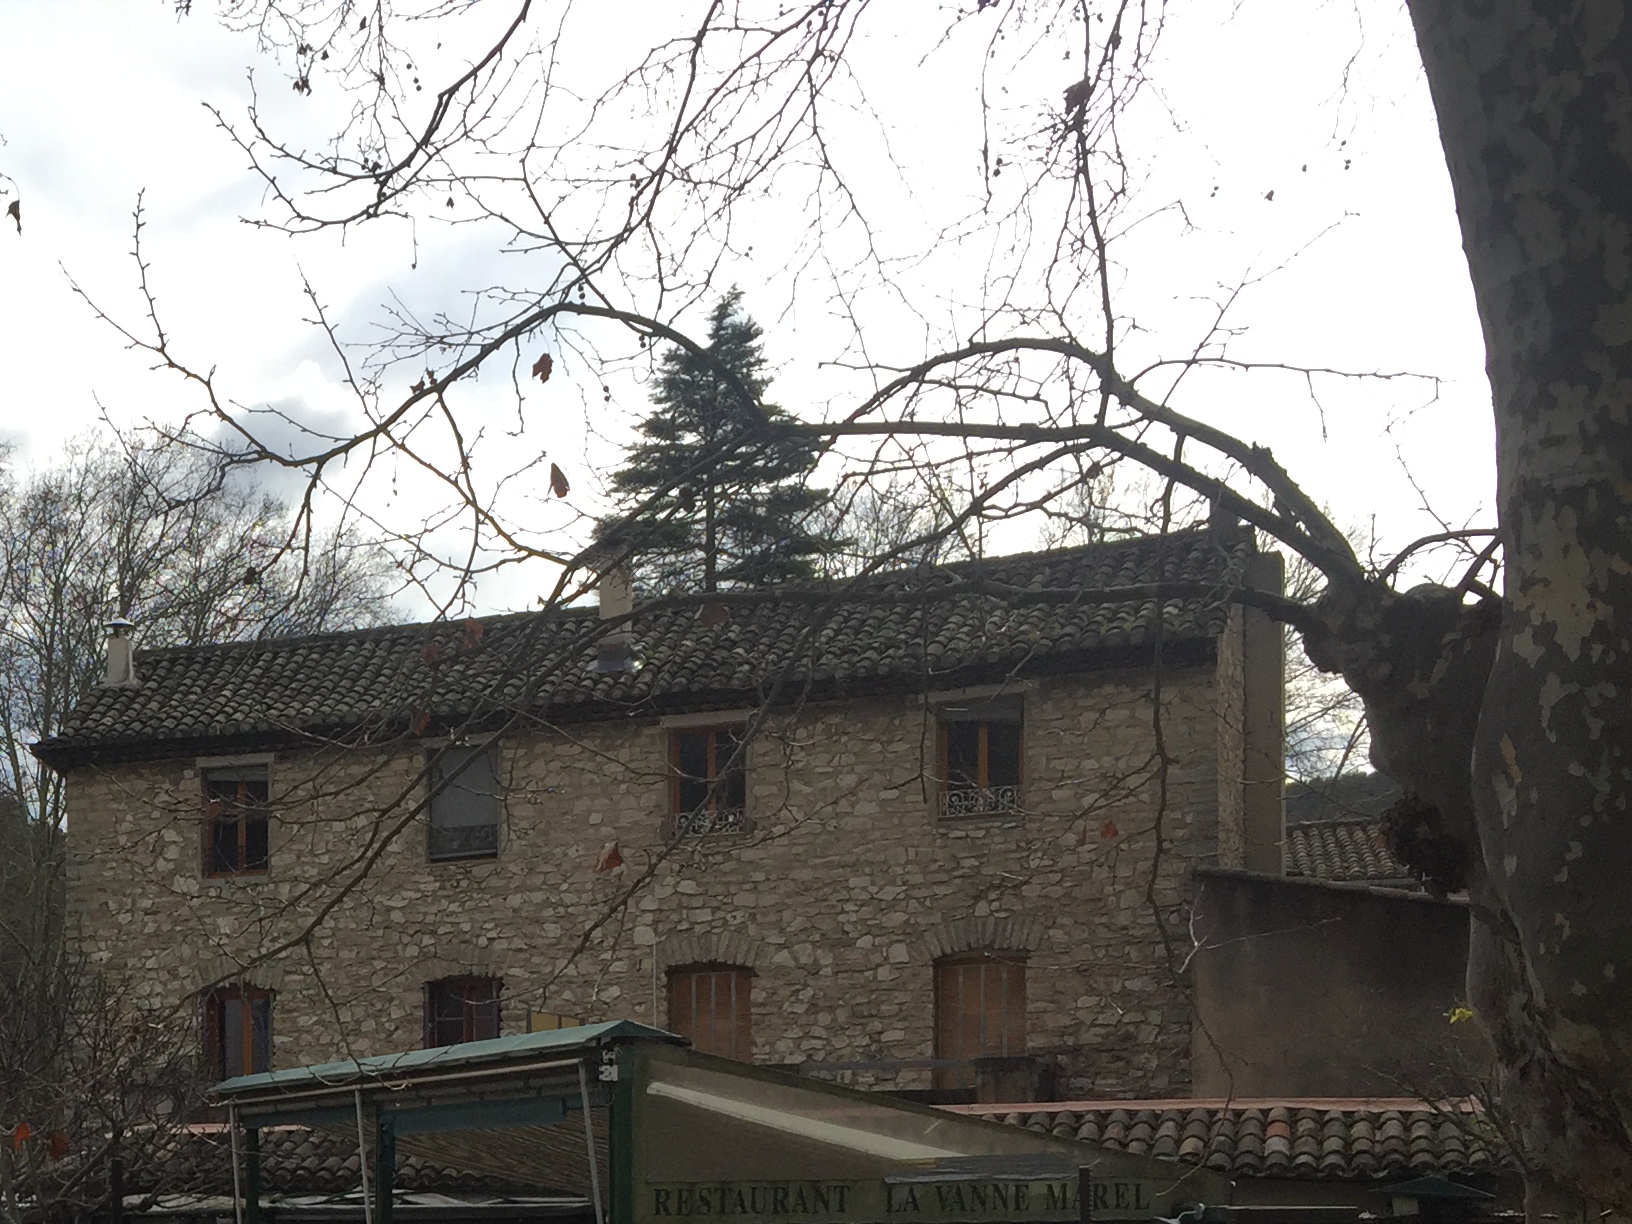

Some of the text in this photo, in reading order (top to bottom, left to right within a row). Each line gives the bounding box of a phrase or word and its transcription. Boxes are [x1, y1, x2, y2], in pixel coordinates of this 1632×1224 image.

[653, 1184, 851, 1217] RESTAURANT
[885, 1184, 921, 1213] LA
[934, 1183, 1030, 1213] VANNE
